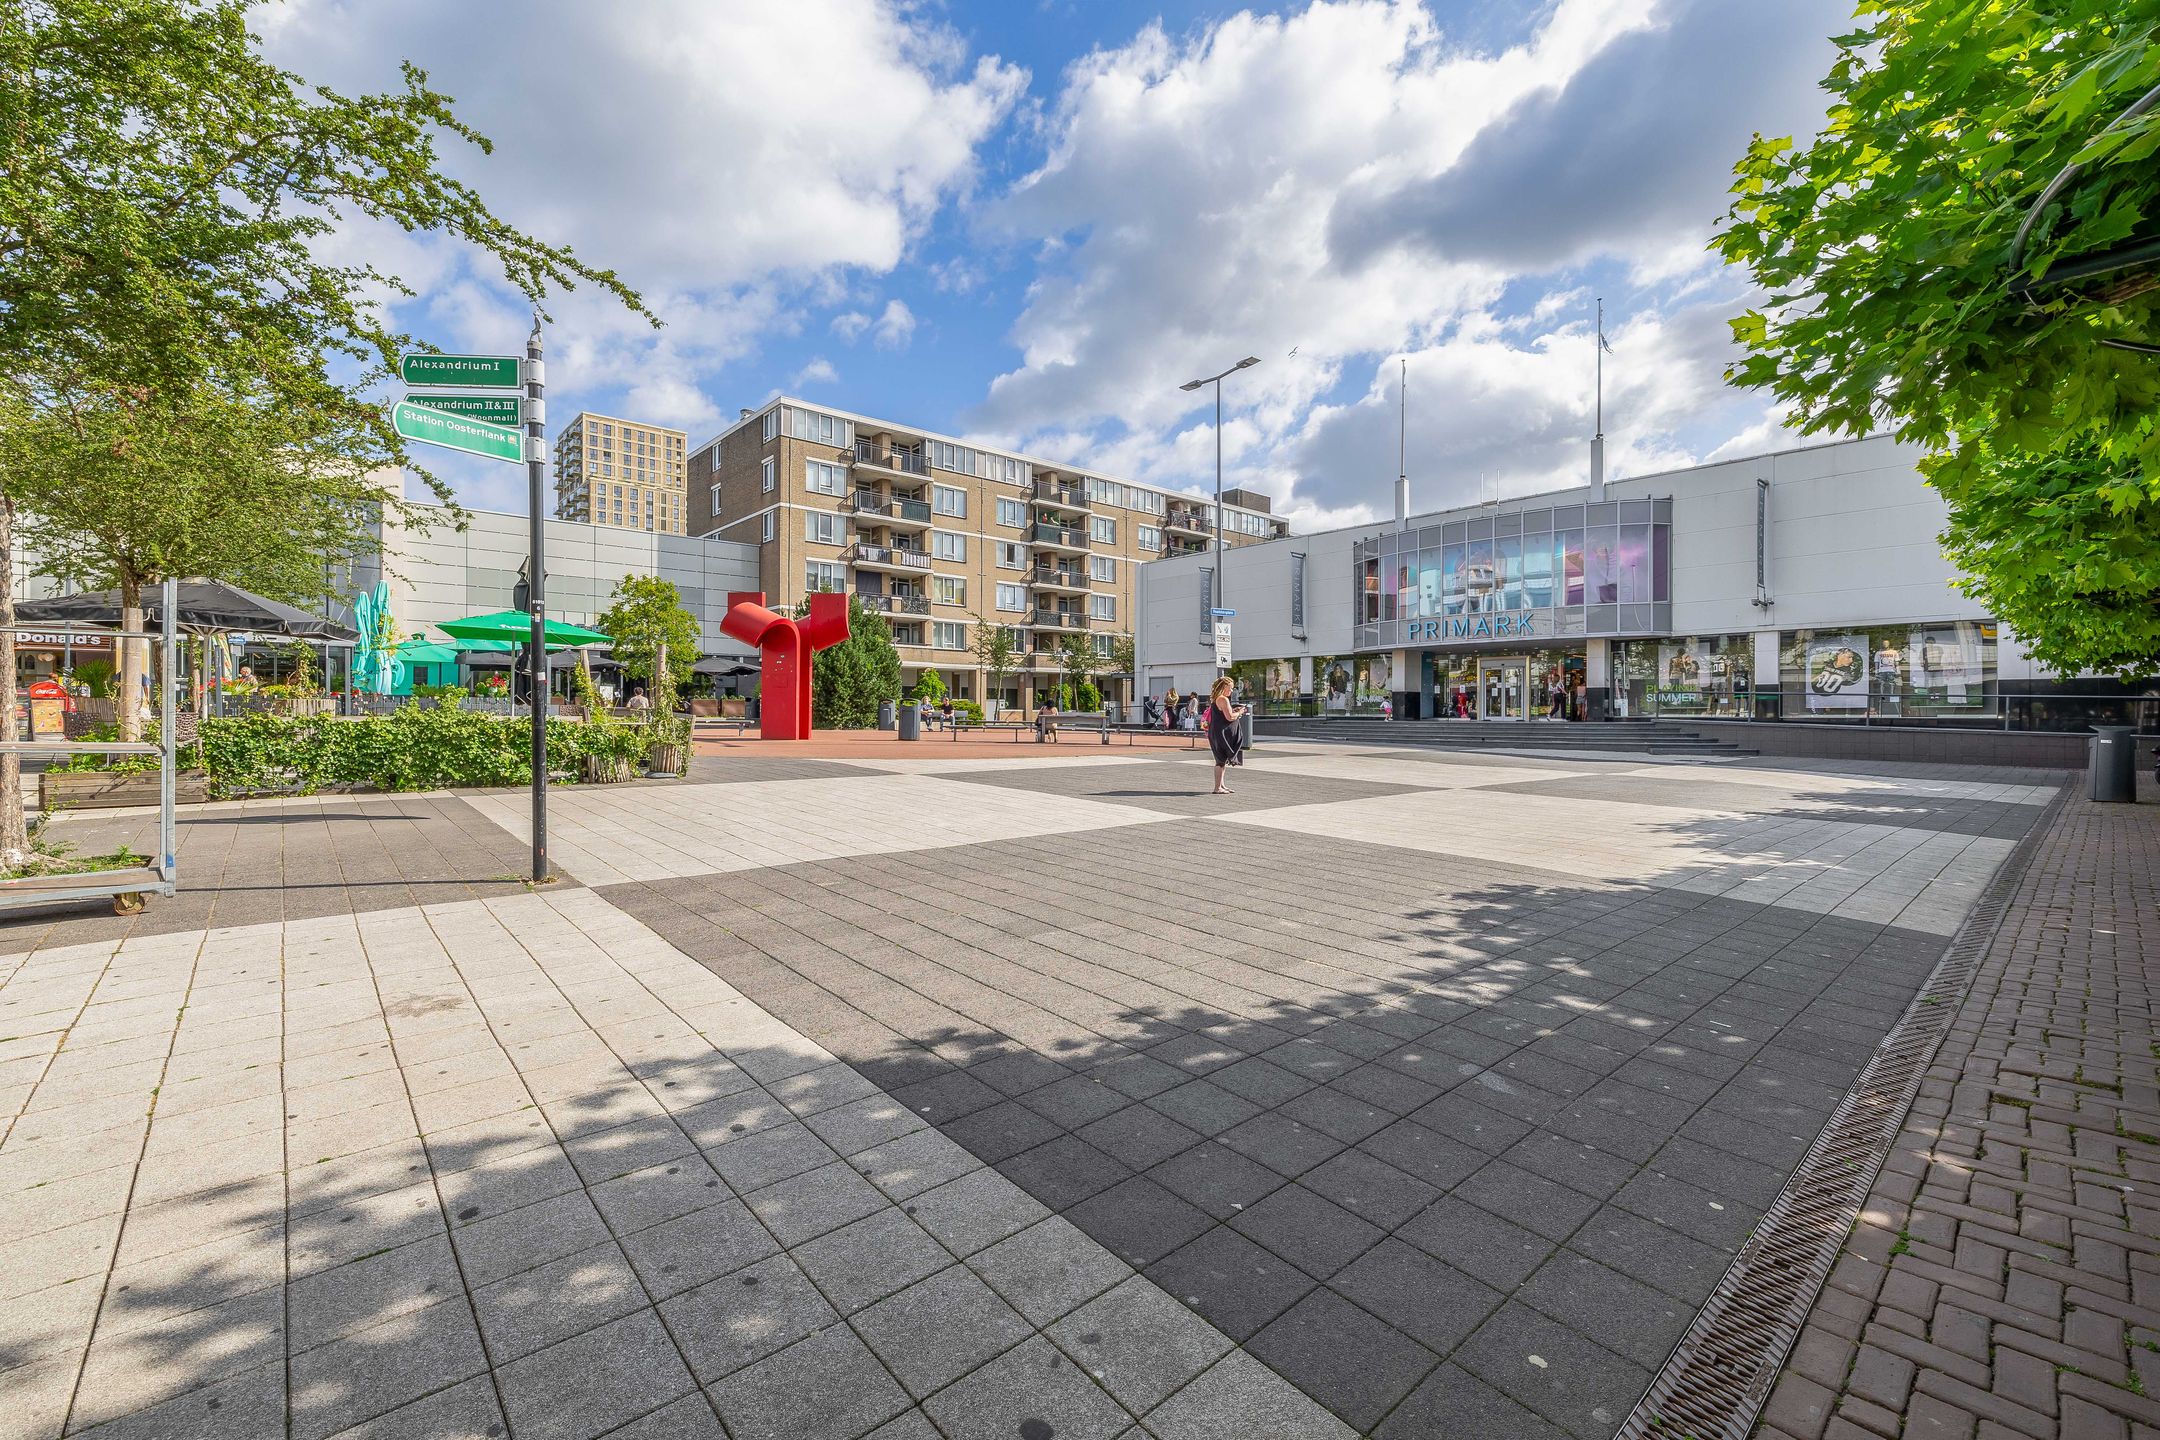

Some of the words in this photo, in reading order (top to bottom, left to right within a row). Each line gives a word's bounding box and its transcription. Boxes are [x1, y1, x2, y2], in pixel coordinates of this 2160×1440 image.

[410, 359, 491, 371] Alexandrium
[493, 361, 500, 371] I
[412, 400, 483, 410] Alexandrium
[403, 410, 444, 428] Station
[446, 419, 506, 443] Oosterflank
[1408, 613, 1534, 640] PRIMARK
[15, 632, 101, 645] Donald's
[1646, 693, 1697, 702] SUMMER
